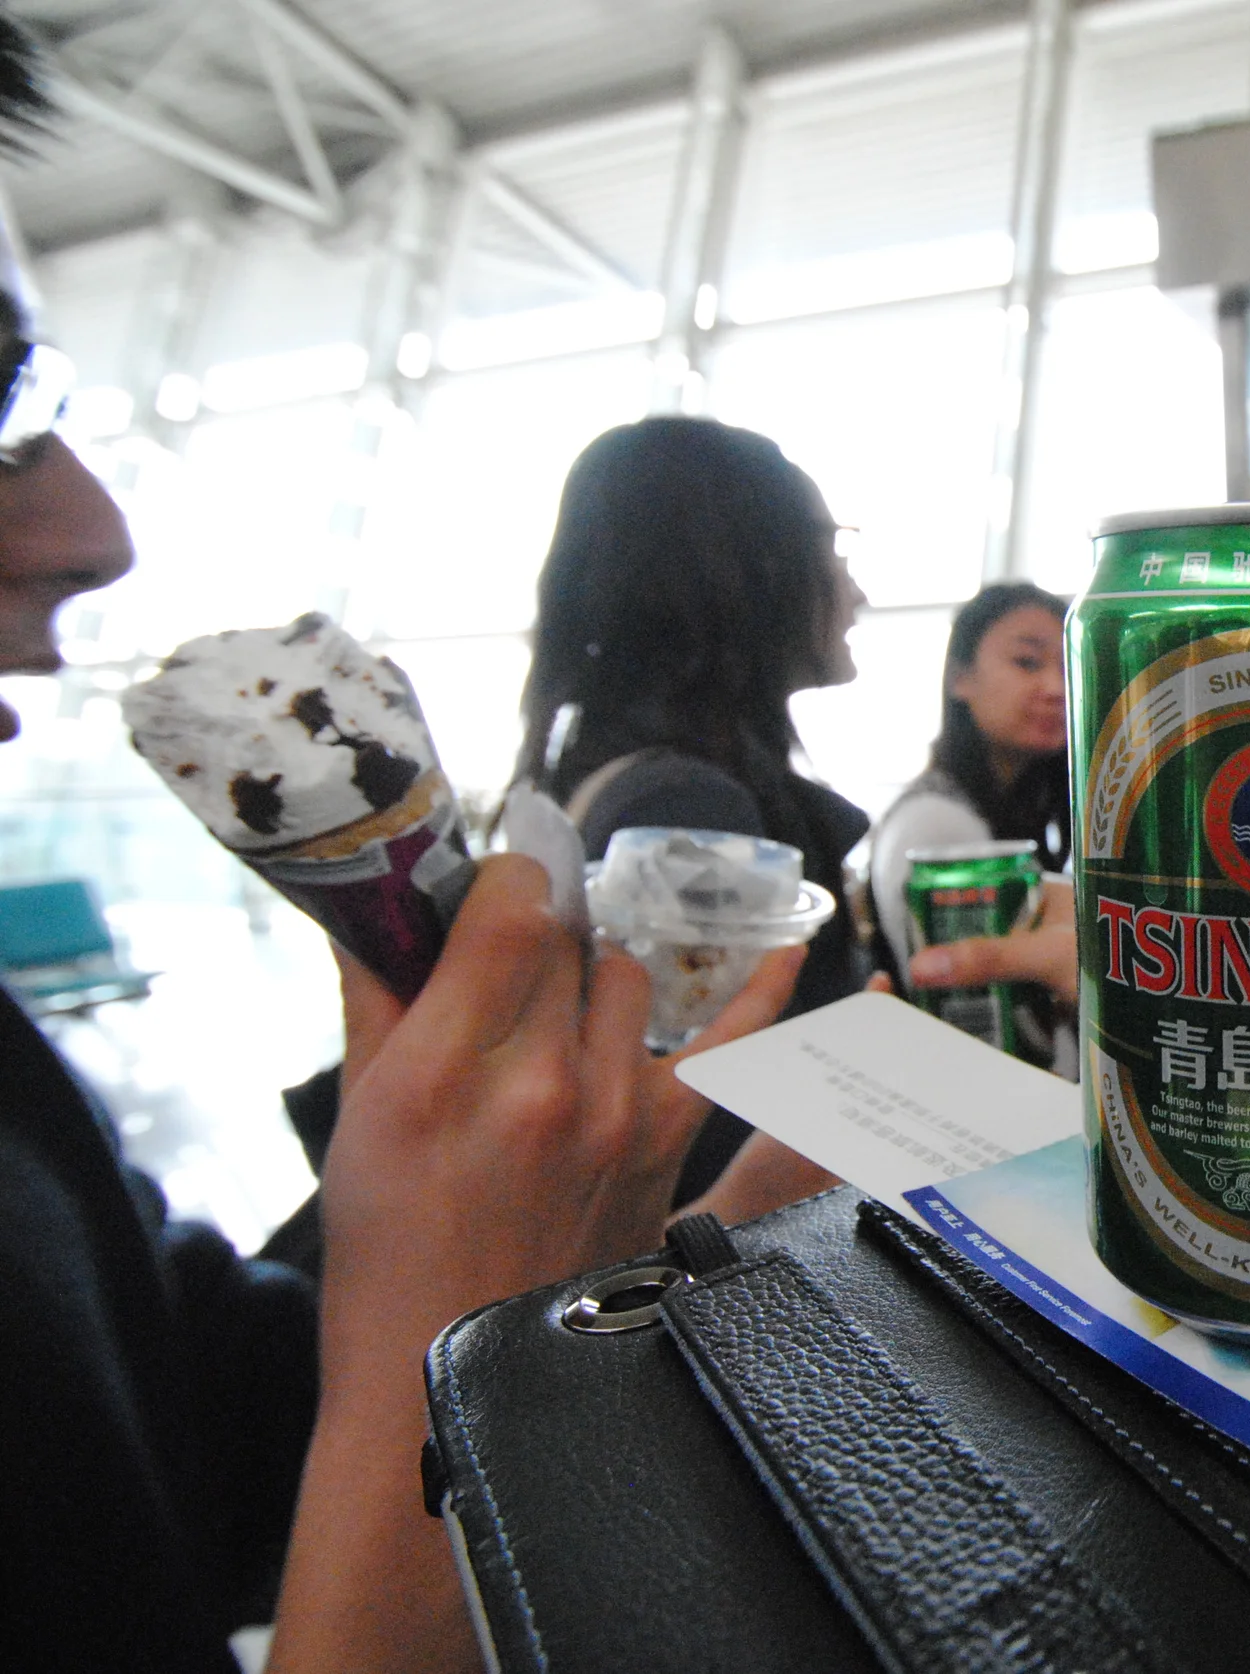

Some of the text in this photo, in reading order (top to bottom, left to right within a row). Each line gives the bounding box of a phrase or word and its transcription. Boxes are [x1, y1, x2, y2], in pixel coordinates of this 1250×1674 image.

[1160, 1090, 1203, 1112] Tsingtao,
[1206, 1101, 1224, 1114] the
[1102, 1073, 1148, 1189] CHINA'S
[1151, 1104, 1168, 1119] Our
[1170, 1111, 1203, 1126] master
[1206, 1117, 1250, 1132] brewers
[1150, 1121, 1167, 1134] and
[1168, 1125, 1199, 1144] barley
[1201, 1133, 1238, 1148] malted
